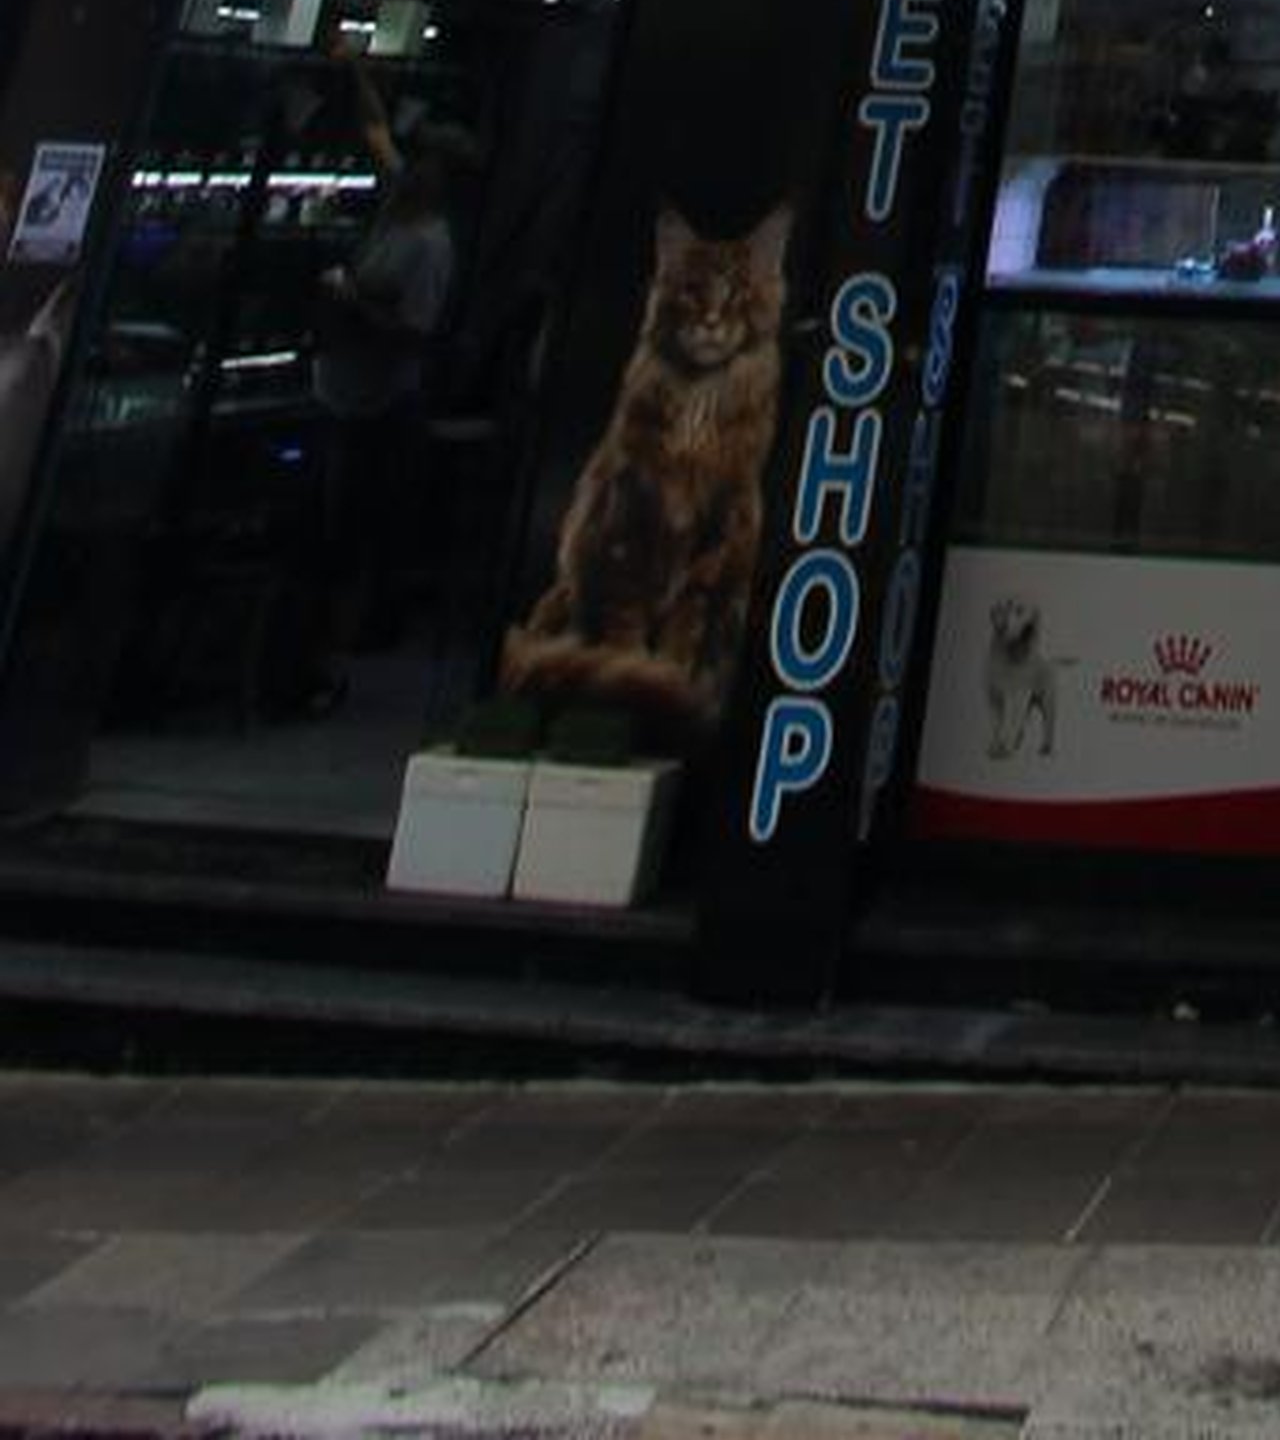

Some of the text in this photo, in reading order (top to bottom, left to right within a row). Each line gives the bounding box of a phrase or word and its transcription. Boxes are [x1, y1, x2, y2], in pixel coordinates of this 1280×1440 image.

[748, 270, 899, 844] SHOP
[1101, 677, 1253, 714] ROYAL CANIN
